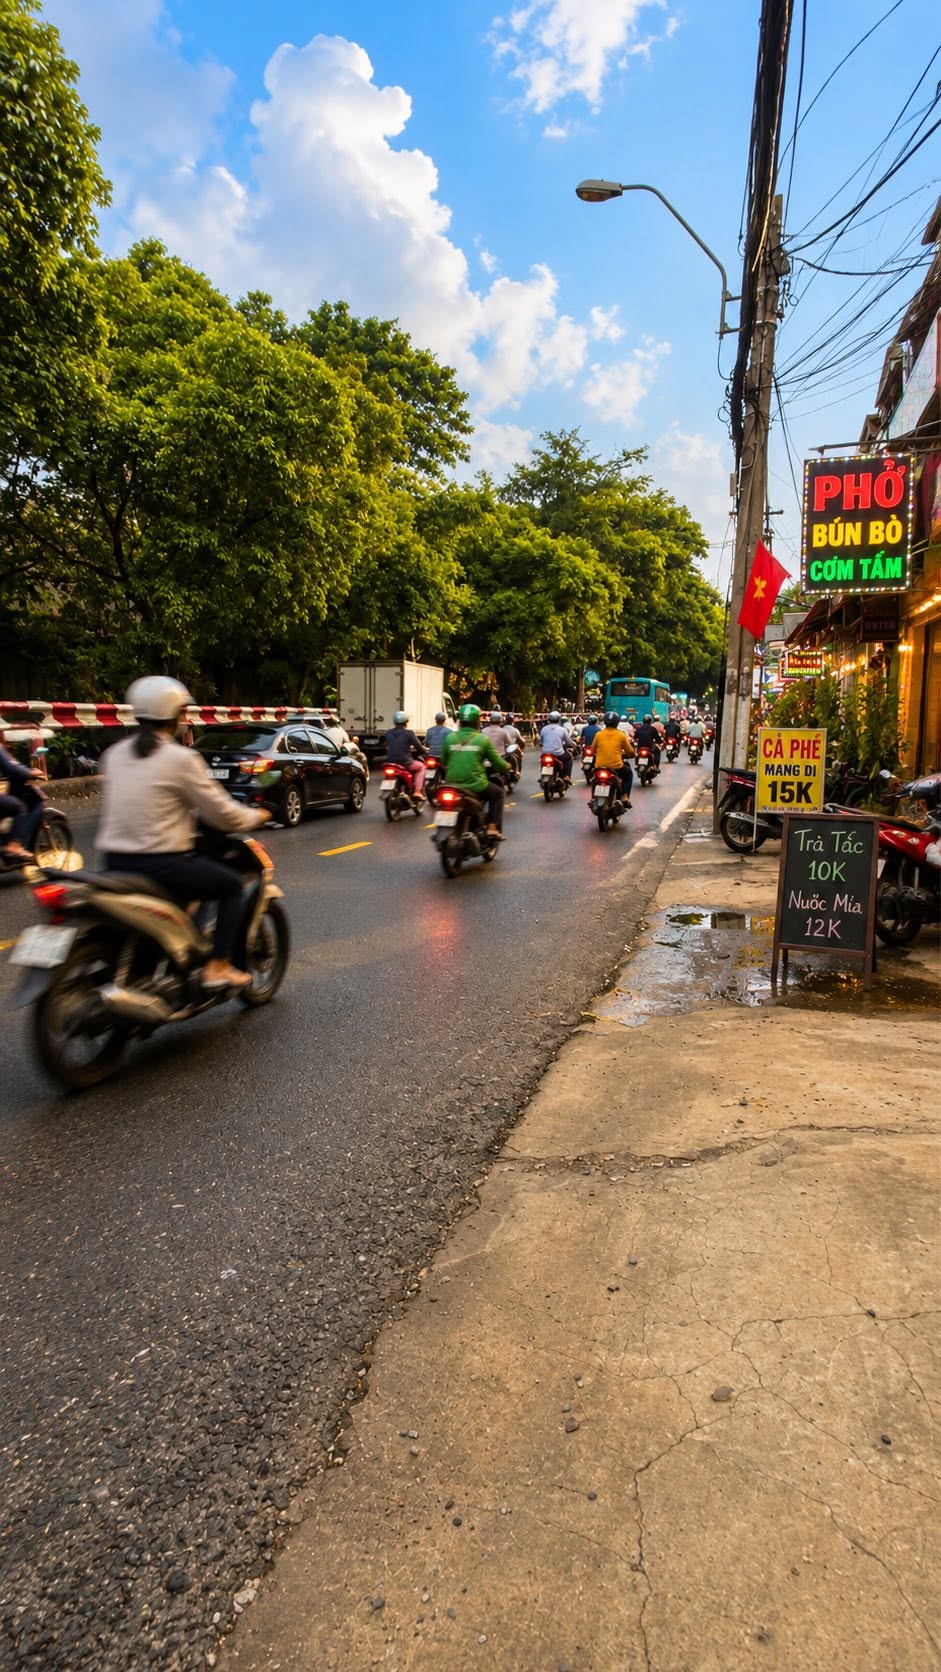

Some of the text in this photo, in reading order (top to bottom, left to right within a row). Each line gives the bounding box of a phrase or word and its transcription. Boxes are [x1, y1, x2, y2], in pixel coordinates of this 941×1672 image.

[813, 459, 907, 512] PHỞ
[812, 514, 903, 548] BÚN BÒ
[810, 550, 902, 581] CƠM TẤM
[765, 764, 800, 777] MANG
[768, 781, 813, 804] 15K
[808, 860, 846, 882] 10K
[804, 917, 842, 939] 12K
